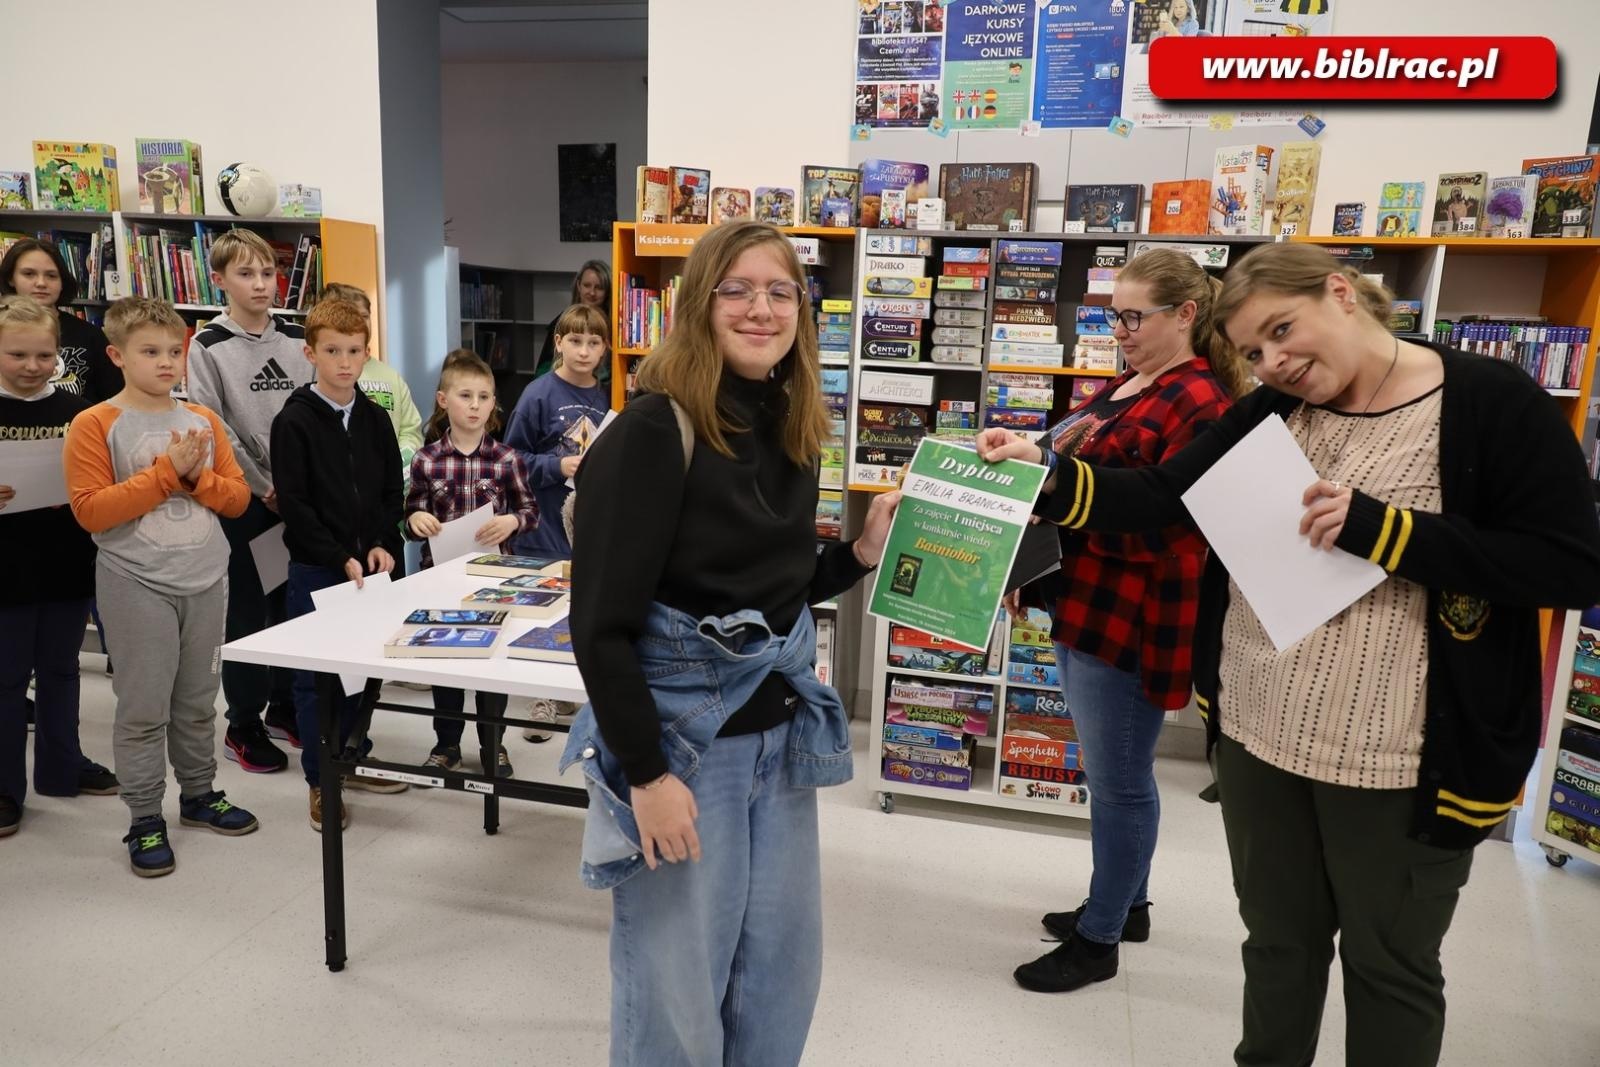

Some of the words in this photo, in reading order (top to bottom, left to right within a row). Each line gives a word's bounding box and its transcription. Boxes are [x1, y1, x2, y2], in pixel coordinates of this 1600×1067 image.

[964, 4, 1026, 16] DARMOWE
[1059, 5, 1078, 13] PWN
[986, 17, 1025, 30] KURSY
[962, 32, 1024, 45] JĘZYKOWE
[879, 47, 904, 55] Czemu
[980, 46, 1023, 58] ONLINE
[141, 142, 184, 155] HISTORIA
[808, 169, 824, 179] TOP
[1282, 227, 1296, 235] 327
[639, 234, 680, 246] Książka
[682, 236, 694, 245] za
[1096, 256, 1115, 267] QUIZ
[1016, 307, 1034, 315] PARK
[874, 321, 908, 332] CENTURY
[869, 343, 907, 355] CENTURY
[250, 378, 295, 393] adidas
[866, 453, 886, 462] TIME
[938, 456, 1015, 487] Dyplom
[911, 478, 954, 500] EMILIA
[957, 491, 1016, 516] BRANICKA
[912, 503, 924, 514] Za
[924, 507, 952, 523] zajęcie
[960, 516, 1004, 536] miejsca
[921, 521, 962, 540] konkursie
[963, 532, 993, 549] wiedzy
[914, 536, 982, 565] Baśniobór
[1009, 741, 1062, 760] Spaghetti
[1008, 763, 1077, 783] REBUSY
